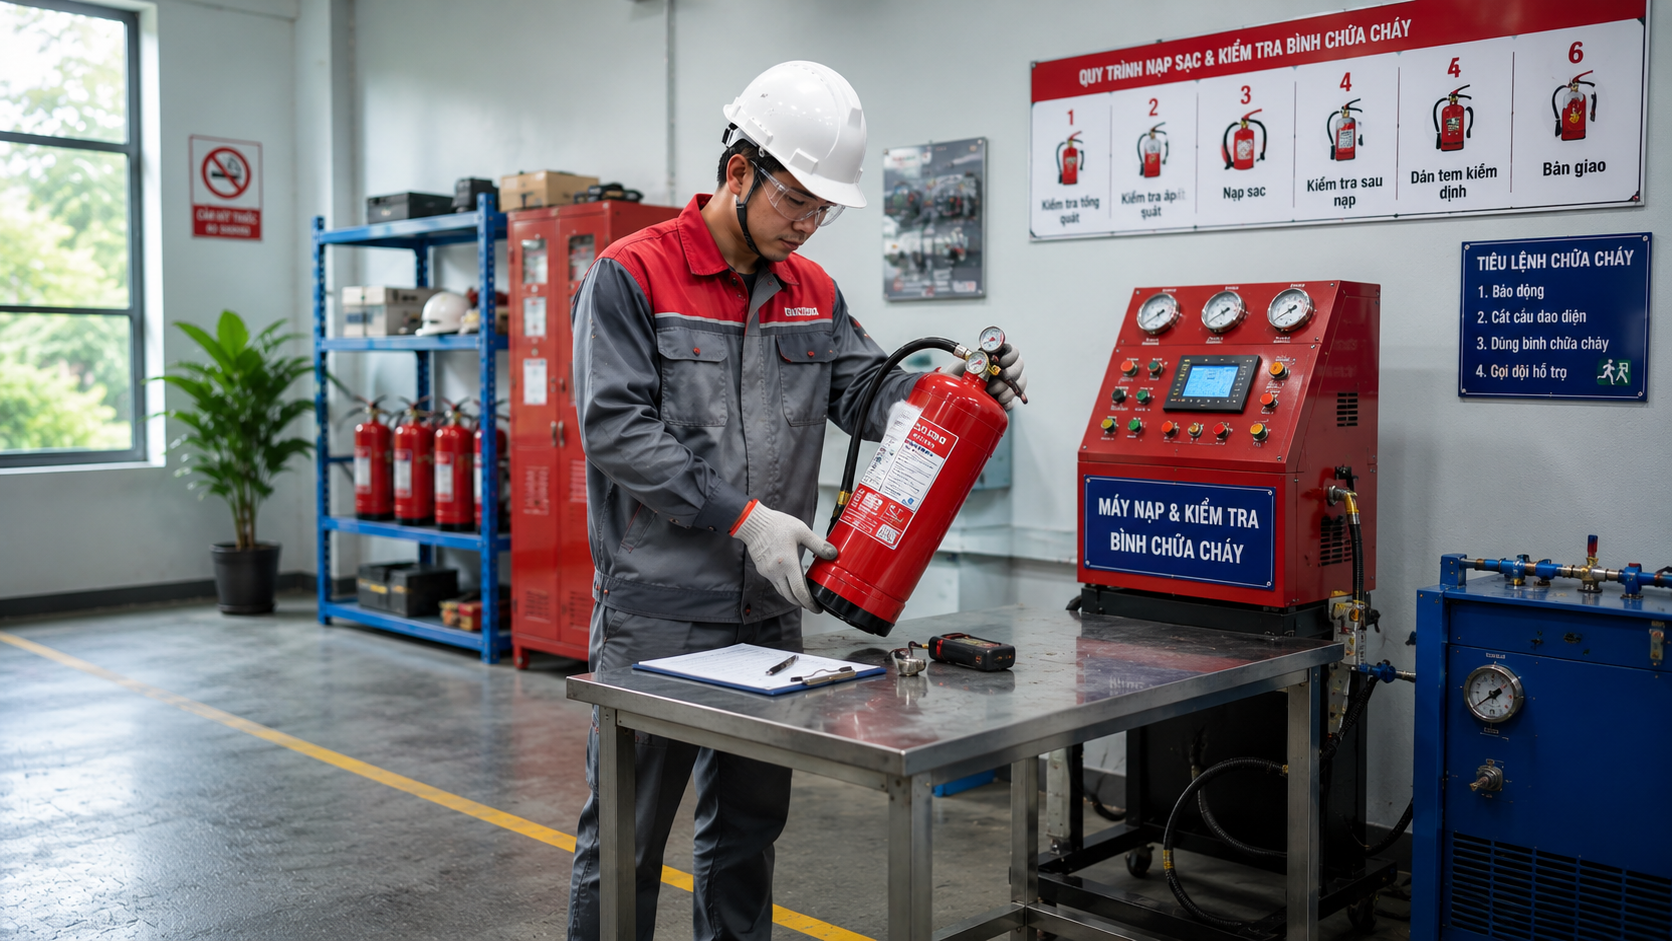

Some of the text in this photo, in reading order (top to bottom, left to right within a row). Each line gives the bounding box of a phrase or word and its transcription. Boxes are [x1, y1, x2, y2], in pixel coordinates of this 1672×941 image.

[1079, 67, 1103, 87] QUY
[1106, 60, 1142, 80] TRÌNH
[1146, 56, 1172, 77] NẠP
[1175, 51, 1201, 73] SẠC
[1204, 50, 1214, 66] &
[1255, 39, 1282, 59] TRA
[1287, 33, 1320, 54] BÌNH
[1370, 17, 1411, 42] CHÁY
[1568, 41, 1584, 64] 6
[1339, 72, 1352, 92] 4
[1240, 85, 1251, 105] 3
[1148, 98, 1159, 116] 2
[1067, 109, 1074, 126] 1
[1438, 168, 1462, 182] tem
[1574, 158, 1606, 178] giao
[1340, 177, 1357, 190] tra
[1361, 176, 1383, 189] sau
[1148, 191, 1161, 202] tra
[1223, 187, 1244, 202] Nạp
[1334, 195, 1356, 209] nạp
[1477, 245, 1634, 273] TIÊU LỆNH CHỮA CHÁY
[1478, 285, 1488, 298] 1.
[1477, 311, 1488, 324] 2.
[1537, 309, 1558, 323] dao
[1476, 337, 1487, 350] 3.
[1475, 364, 1487, 378] 4.
[1490, 364, 1508, 380] Gọi
[1098, 493, 1259, 529] MÁY NẠP & KIỂM TRA
[1110, 527, 1244, 564] BÌNH CHỮA CHÁY
